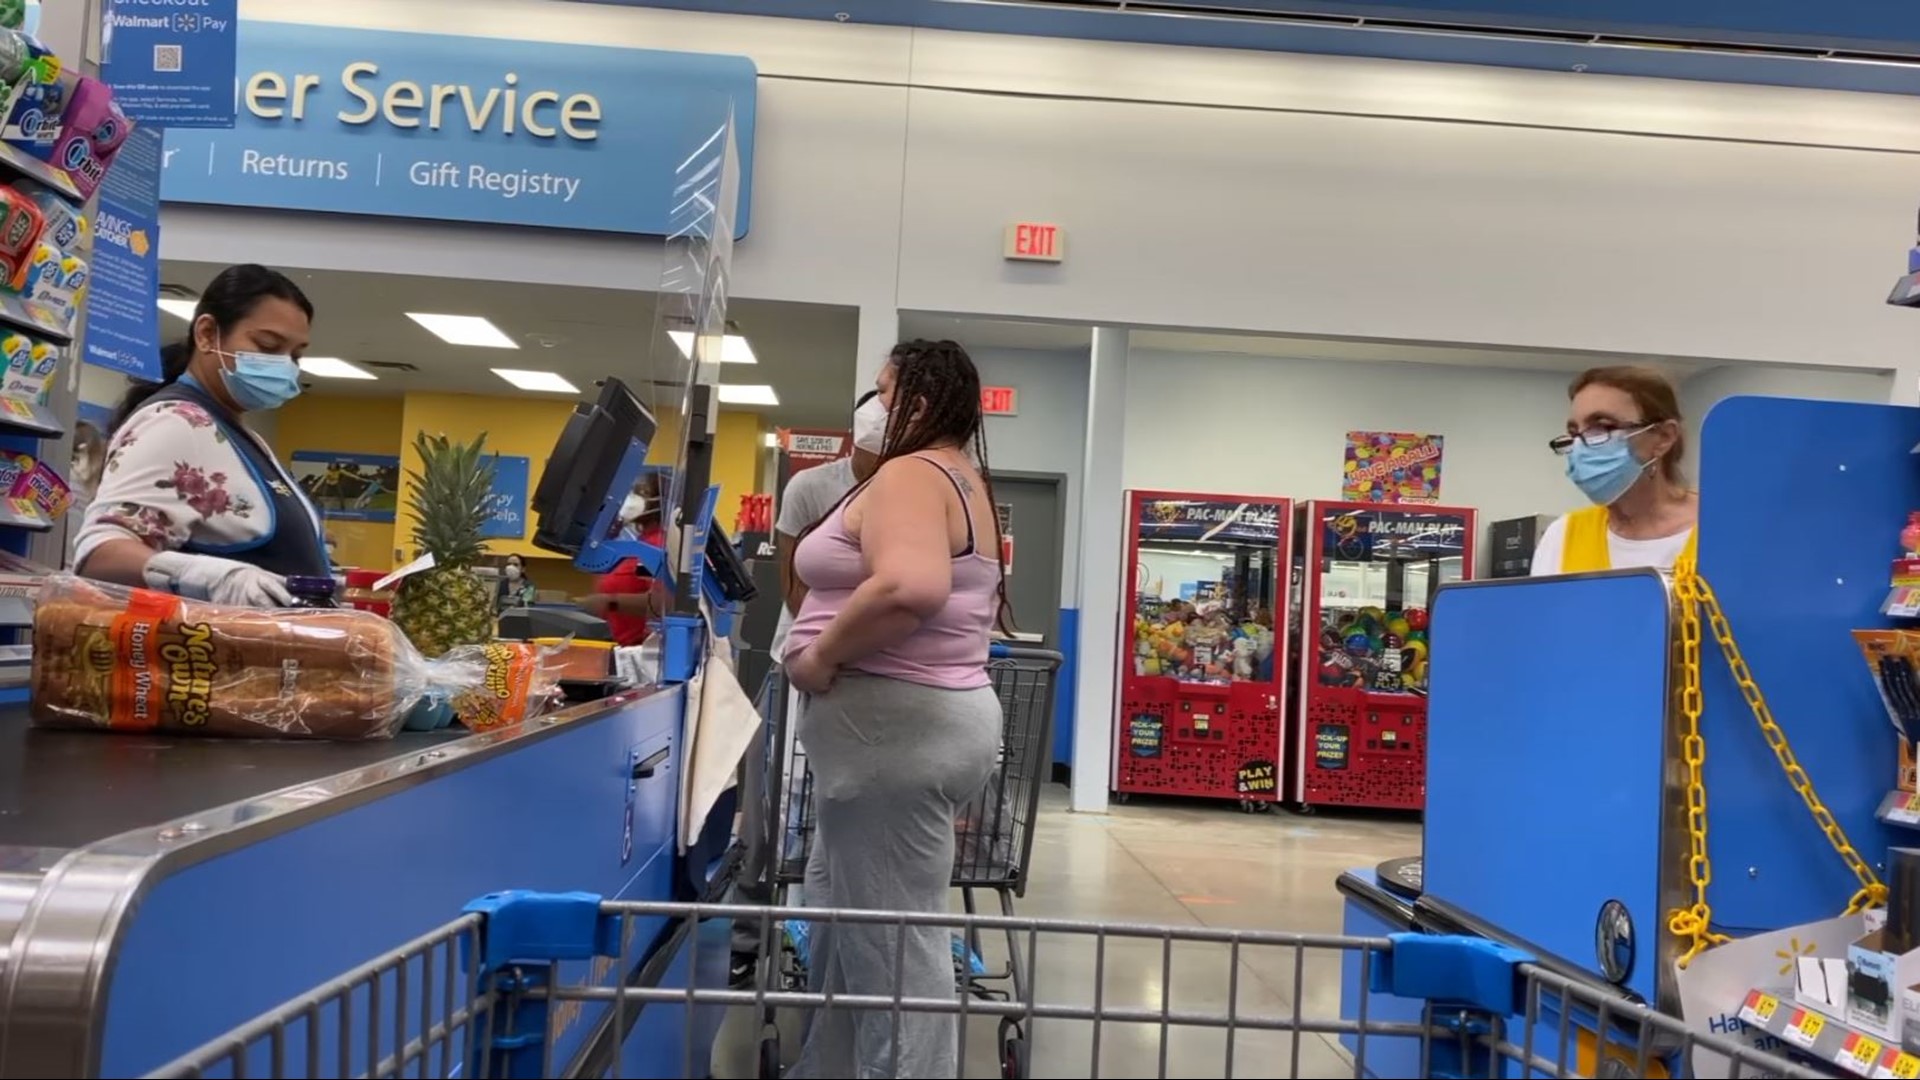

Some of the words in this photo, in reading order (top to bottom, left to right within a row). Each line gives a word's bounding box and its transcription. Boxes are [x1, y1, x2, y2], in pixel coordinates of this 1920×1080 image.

[113, 15, 169, 28] Walmart
[203, 17, 227, 32] Pay
[243, 69, 320, 120] er
[338, 61, 603, 140] Service
[62, 136, 104, 181] Orbit
[242, 150, 349, 179] Returns
[409, 161, 460, 188] Gift
[468, 165, 581, 202] Registry
[97, 211, 132, 239] AVINGS
[1016, 224, 1056, 256] EXIT
[982, 389, 1012, 411] EXIT
[1350, 461, 1386, 484] HAVE
[1186, 507, 1242, 521] PAC-MAN
[1368, 521, 1425, 534] PAC-MAN
[1428, 523, 1459, 535] PLAY
[129, 622, 150, 667] Honey
[162, 643, 190, 710] Own
[178, 622, 218, 726] Nature's
[134, 670, 151, 719] Wheat
[1238, 766, 1272, 780] PLAY
[1709, 1012, 1752, 1036] Hap
